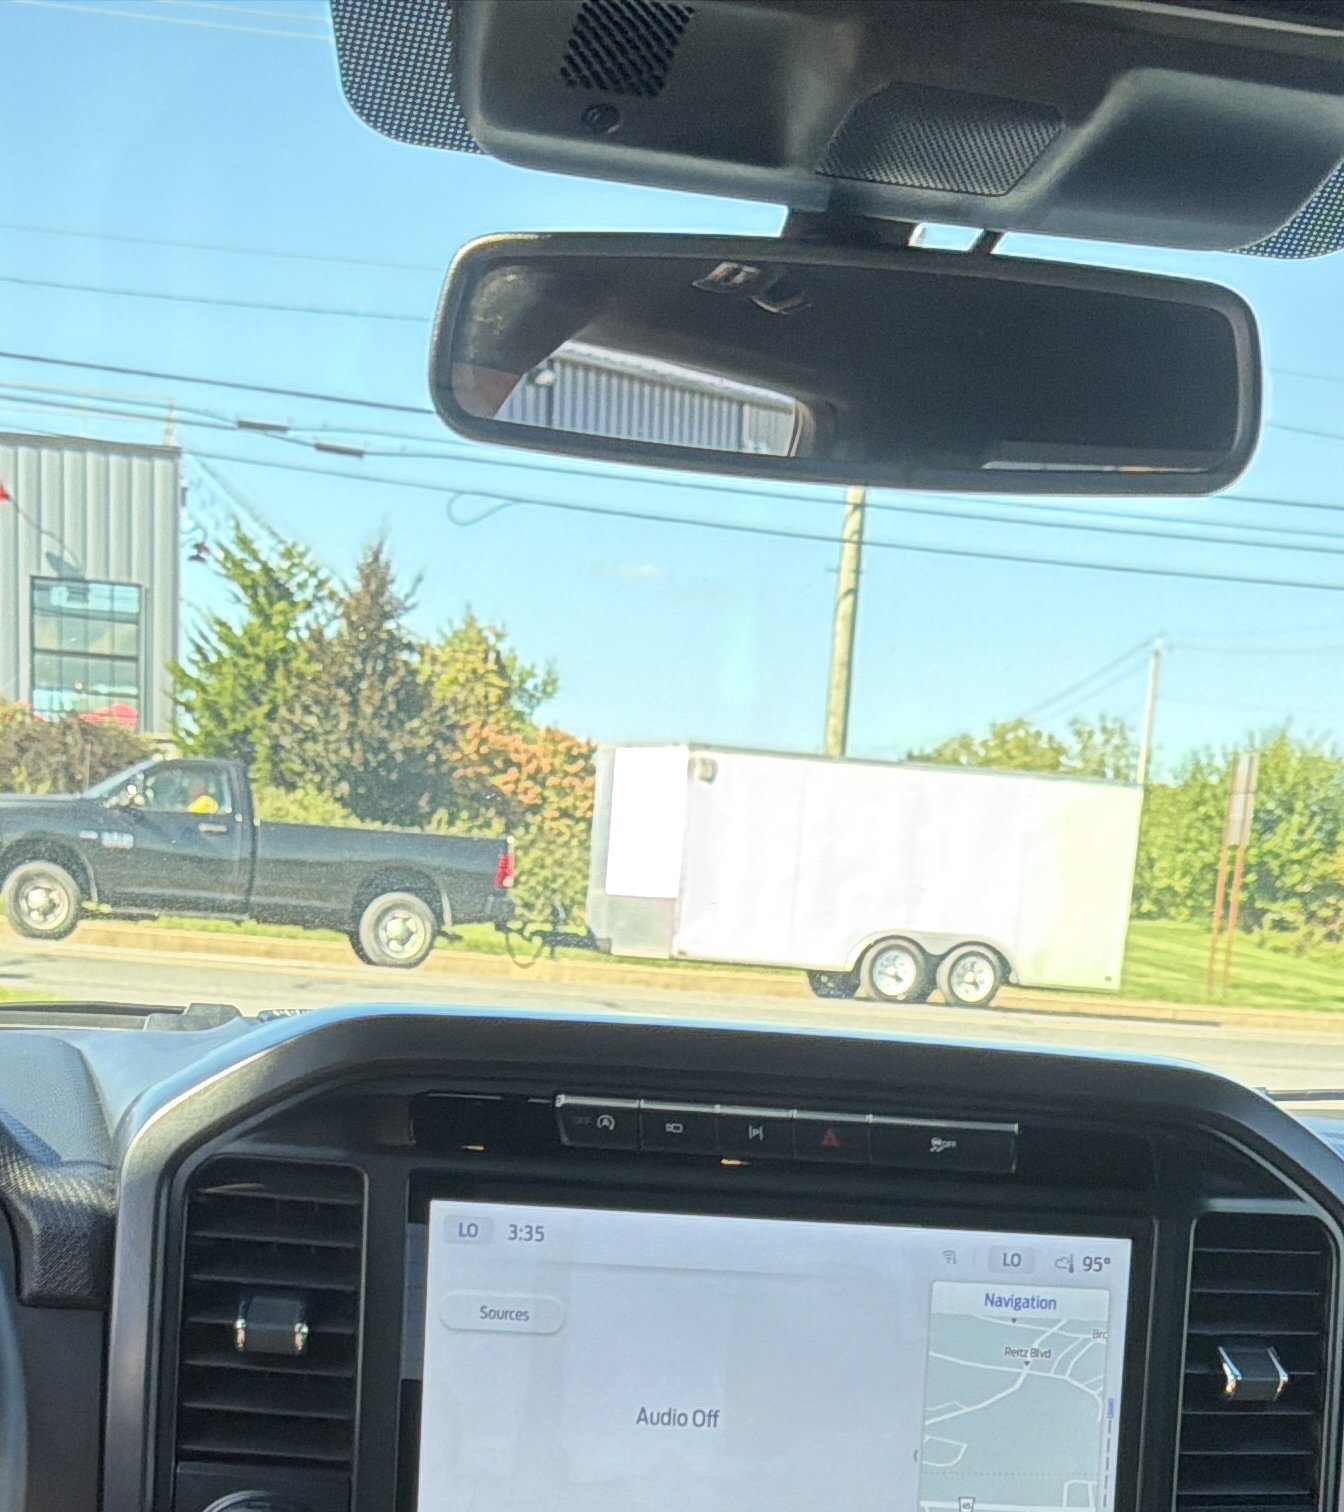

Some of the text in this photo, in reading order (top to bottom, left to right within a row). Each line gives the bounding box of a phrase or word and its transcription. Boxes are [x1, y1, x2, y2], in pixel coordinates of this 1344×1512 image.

[458, 1222, 545, 1242] LO 3:35
[1002, 1252, 1022, 1268] LO
[983, 1292, 1057, 1312] Navigation
[478, 1305, 531, 1323] Sources
[635, 1406, 721, 1429] Audio Off
